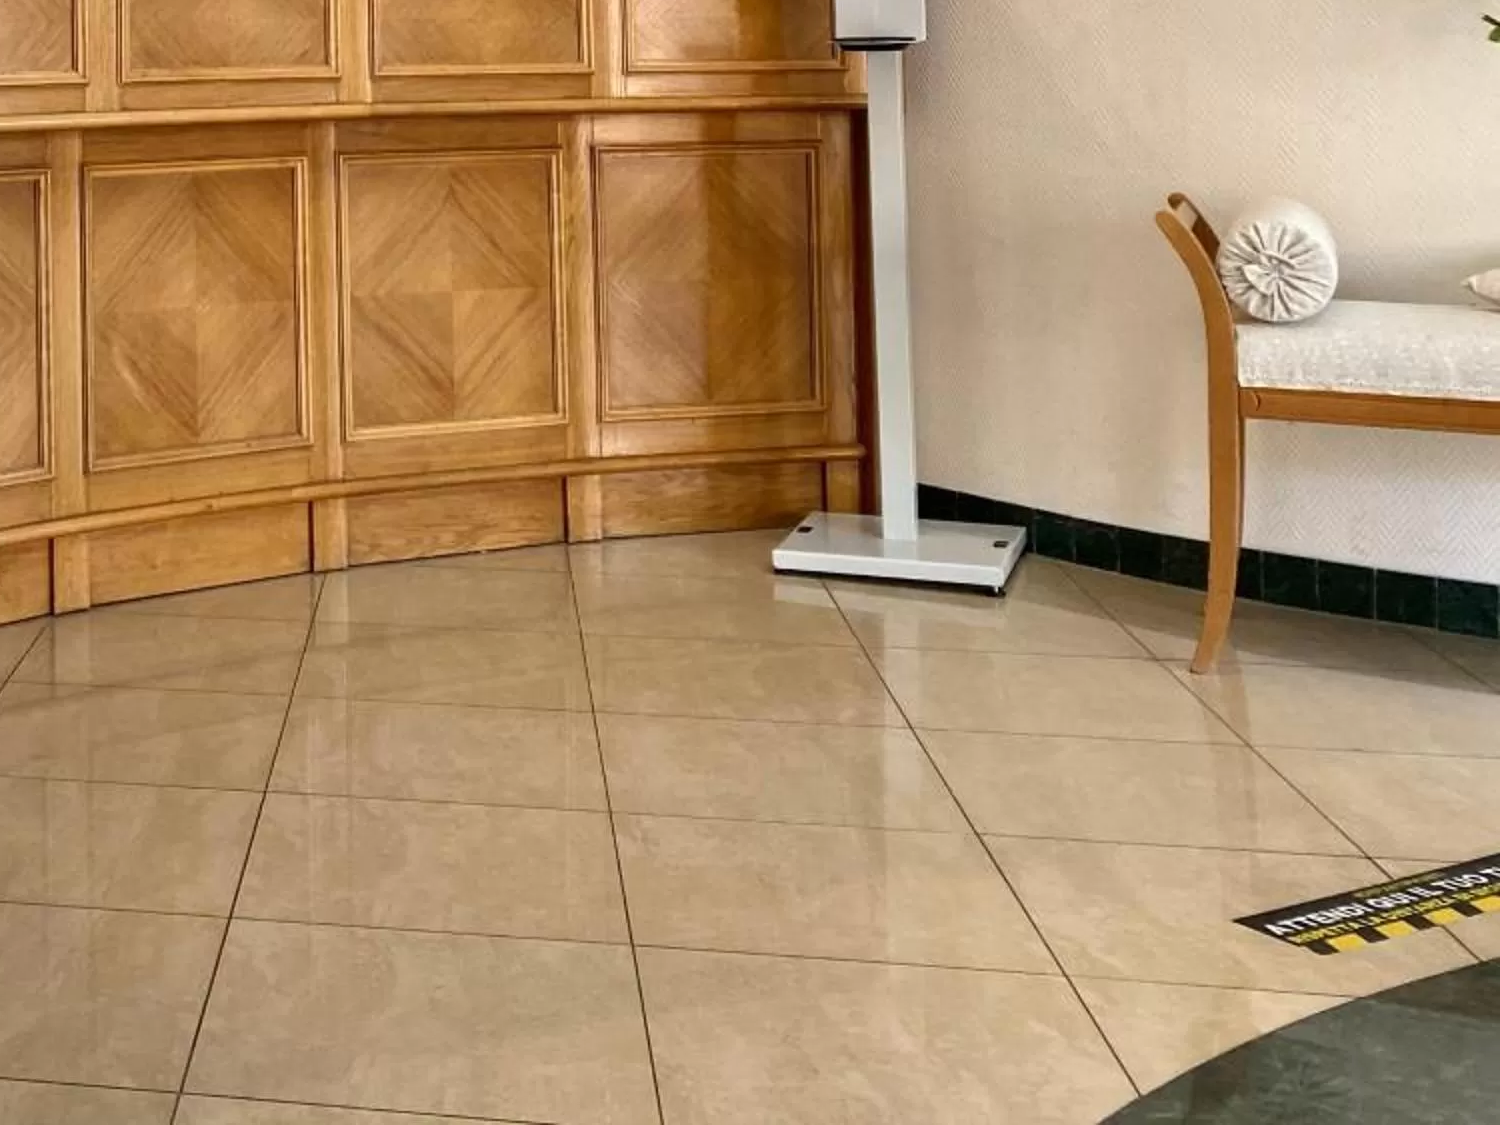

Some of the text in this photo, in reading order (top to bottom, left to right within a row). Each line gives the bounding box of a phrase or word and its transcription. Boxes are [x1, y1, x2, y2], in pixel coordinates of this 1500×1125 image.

[1264, 902, 1374, 936] ATTENDI
[1366, 892, 1419, 909] QUI
[1430, 874, 1489, 892] TUO
